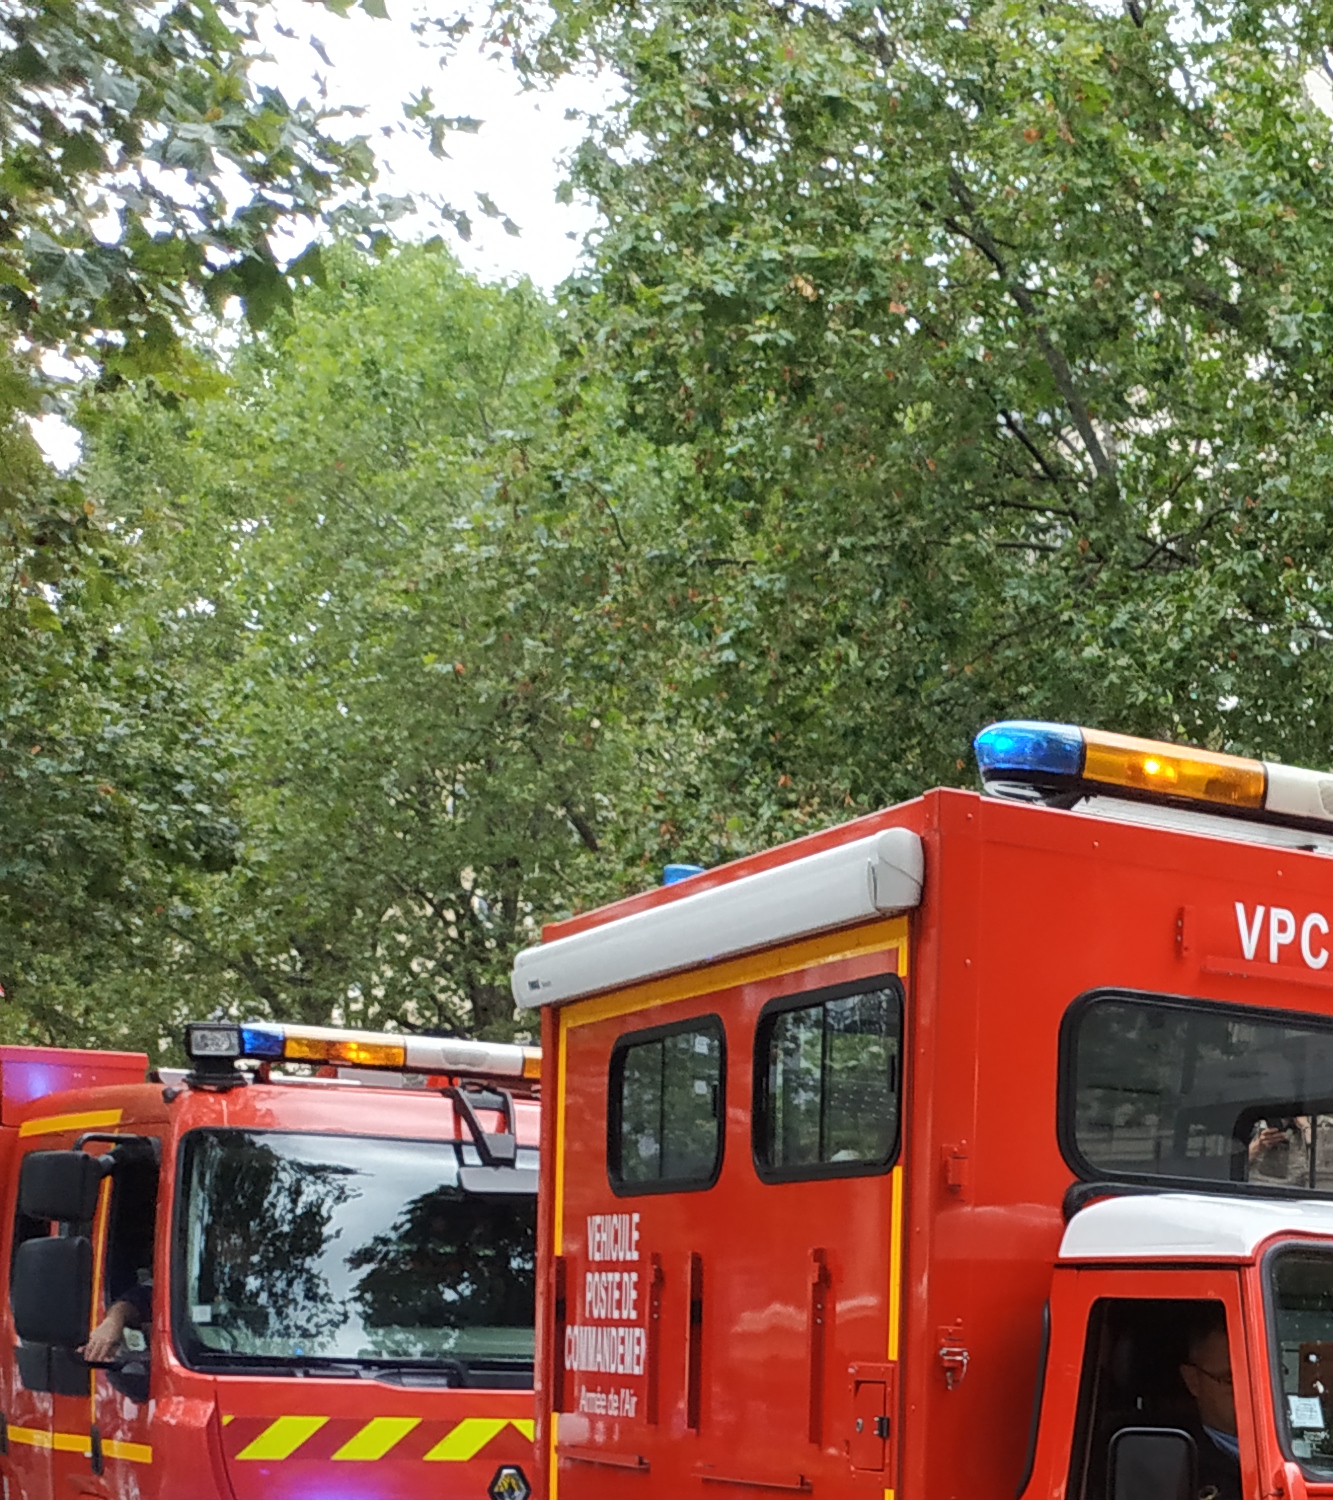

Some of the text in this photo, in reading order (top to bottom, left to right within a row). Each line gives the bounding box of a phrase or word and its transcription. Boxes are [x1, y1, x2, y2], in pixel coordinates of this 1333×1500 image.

[1234, 901, 1330, 970] VPC
[587, 1212, 640, 1261] VEHICULE
[585, 1271, 639, 1320] POSTE DE
